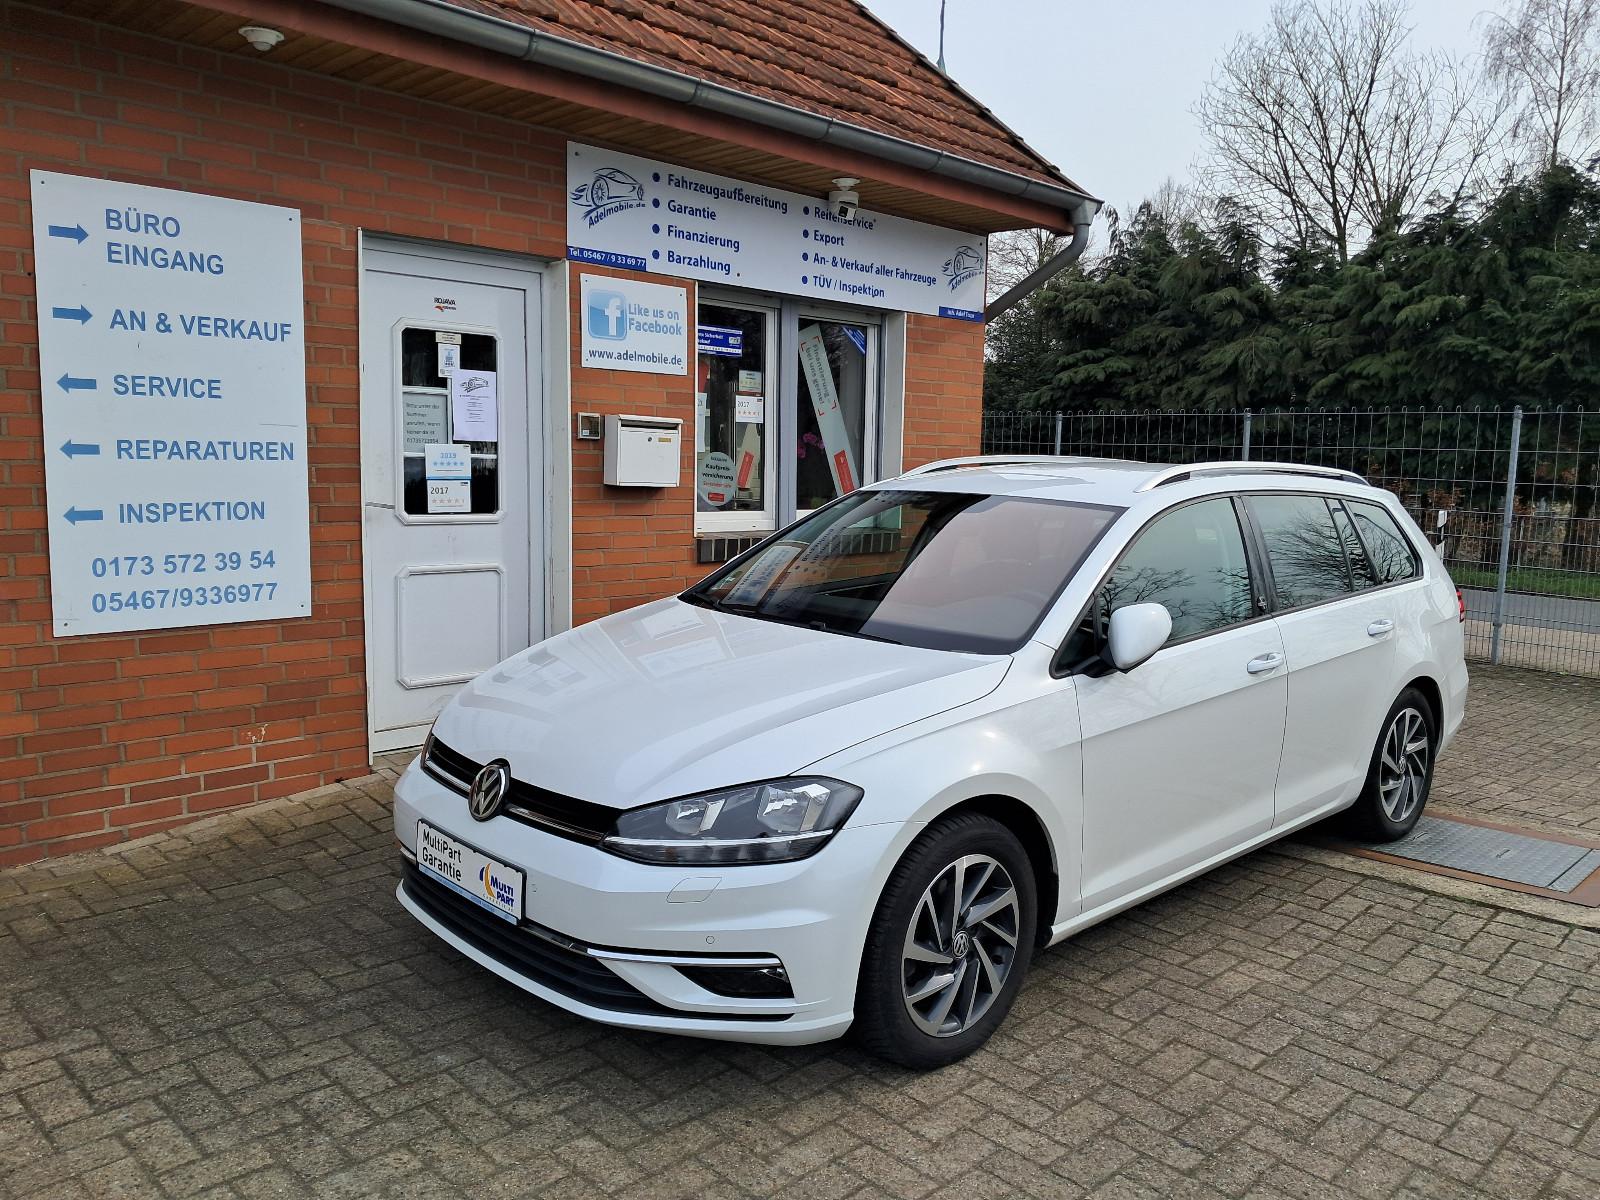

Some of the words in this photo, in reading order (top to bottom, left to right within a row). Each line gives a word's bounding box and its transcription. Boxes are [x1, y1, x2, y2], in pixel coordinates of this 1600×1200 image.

[667, 174, 787, 214] Fahrzeugaufbereitung
[588, 202, 645, 229] Adelmobile.de
[667, 200, 716, 220] Garantie
[106, 207, 180, 237] BÜRO
[667, 225, 740, 252] Finanzierung
[814, 230, 844, 246] Export
[107, 242, 223, 274] EINGANG
[569, 248, 582, 256] Tel.
[584, 251, 605, 260] 05467
[617, 256, 625, 264] 33
[667, 251, 730, 275] Barzahlung
[813, 253, 829, 265] An-
[832, 255, 838, 267] &
[840, 257, 874, 274] Verkauf
[875, 265, 893, 277] aller
[896, 268, 936, 286] Fahrzeuge
[813, 275, 832, 289] TÜV
[839, 280, 884, 298] Inspektion
[628, 304, 649, 316] Like
[653, 309, 664, 319] us
[667, 311, 679, 320] on
[110, 309, 145, 331] AN
[156, 313, 172, 333] &
[180, 315, 291, 341] VERKAUF
[628, 318, 682, 335] Facebook
[589, 350, 682, 365] www.adelmobile.de
[114, 375, 221, 398] SERVICE
[117, 440, 293, 460] REPARATUREN
[120, 502, 264, 523] INSPEKTION
[92, 556, 154, 577] 0173
[164, 554, 205, 573] 572
[215, 552, 241, 571] 39
[250, 550, 275, 569] 54
[92, 583, 277, 613] 05467/9336977
[423, 829, 461, 863] MultiPart
[423, 847, 461, 881] Garantie
[491, 875, 513, 896] MULTI
[497, 892, 514, 907] PART
